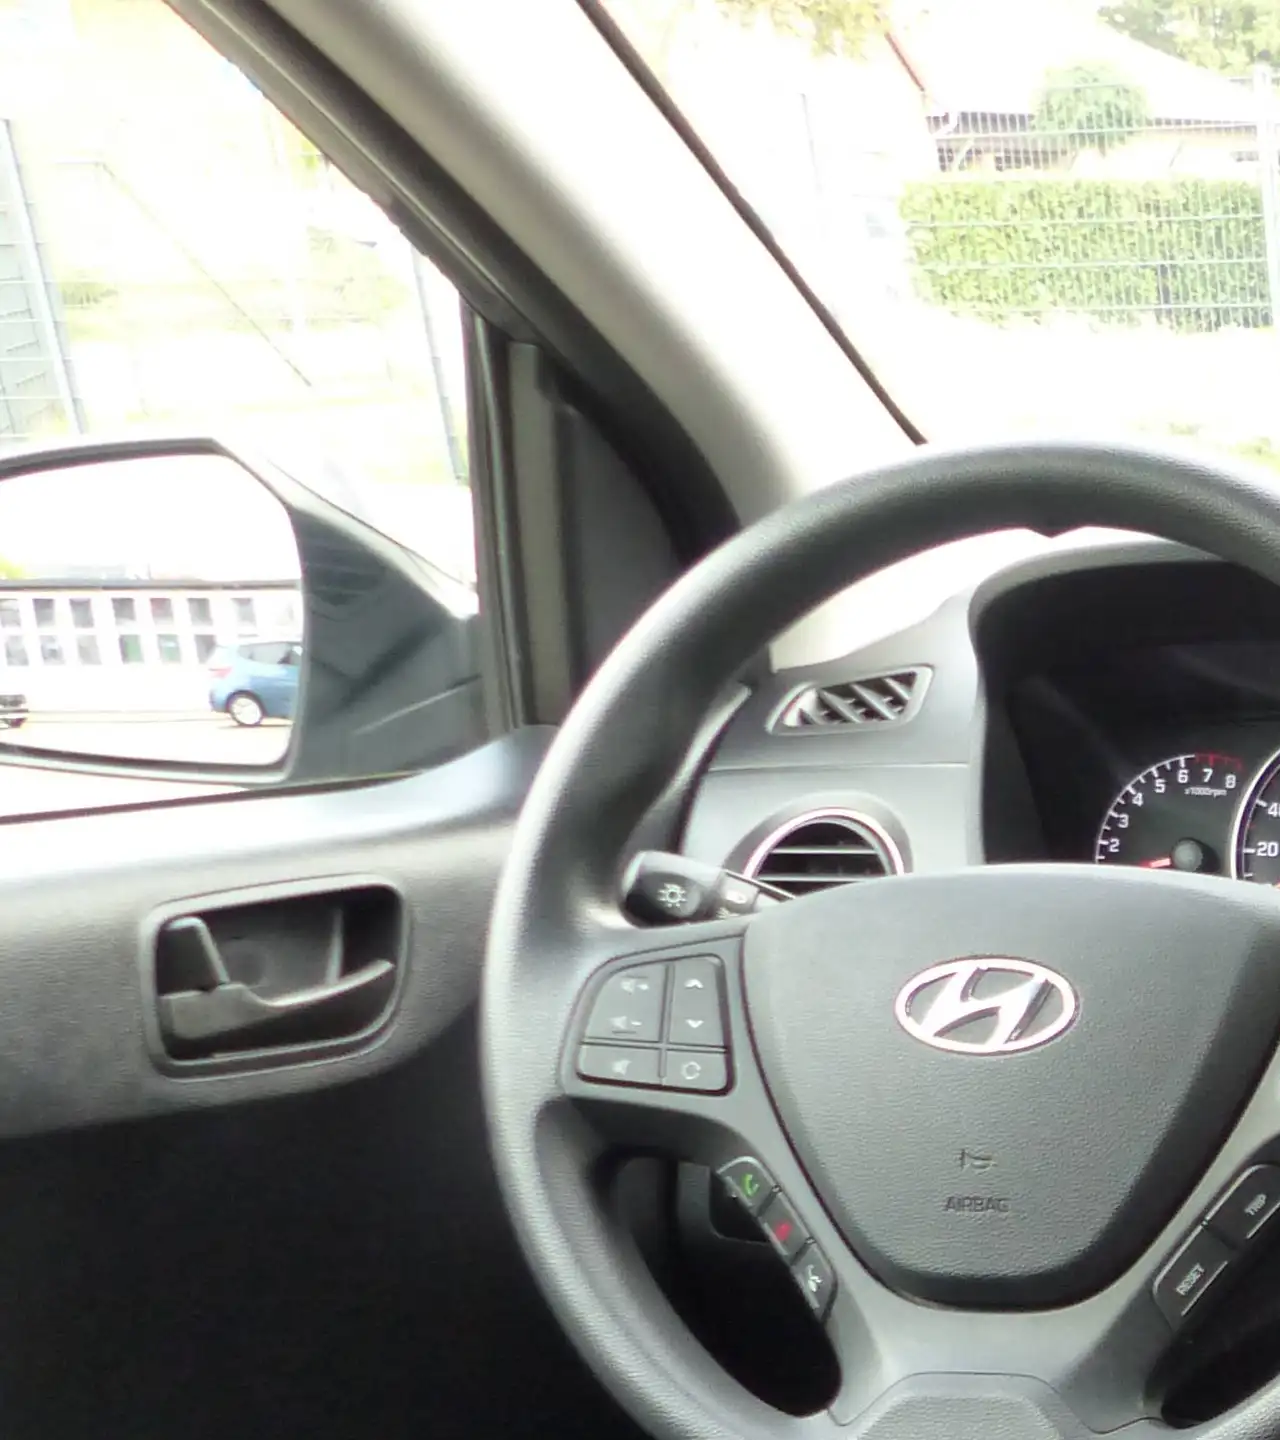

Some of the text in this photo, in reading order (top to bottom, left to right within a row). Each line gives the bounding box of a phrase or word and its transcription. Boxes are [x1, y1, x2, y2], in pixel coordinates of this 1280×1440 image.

[1177, 769, 1189, 783] 6
[1202, 768, 1213, 783] 7
[1225, 774, 1236, 789] 8
[1154, 778, 1166, 793] 5
[1132, 792, 1144, 807] 4
[1117, 813, 1129, 828] 3
[1108, 838, 1120, 853] 2
[1256, 841, 1279, 857] 20
